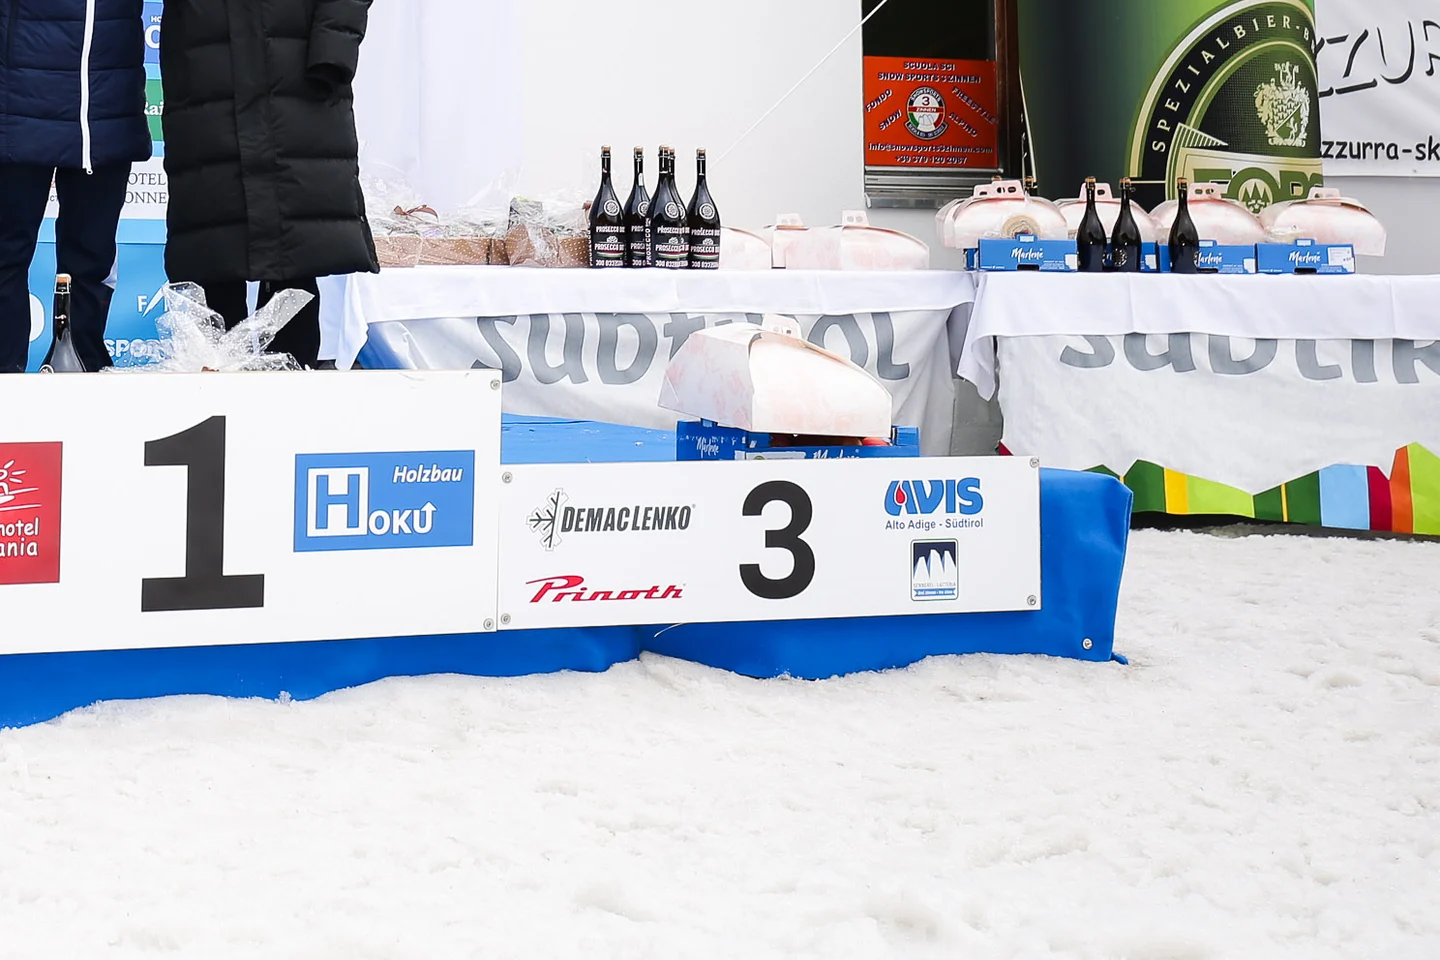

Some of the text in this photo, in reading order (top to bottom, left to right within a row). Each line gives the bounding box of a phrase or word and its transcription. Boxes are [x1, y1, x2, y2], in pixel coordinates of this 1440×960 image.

[904, 62, 956, 71] SCUOLA SCI
[878, 72, 904, 81] SNOW
[905, 73, 940, 82] SPORTS
[948, 75, 981, 84] ZINNEN
[866, 88, 893, 112] FONDO
[921, 96, 930, 106] 3
[951, 87, 996, 125] FREESTYLE
[879, 109, 902, 131] SNOW
[948, 112, 978, 138] ALPINO
[127, 172, 166, 186] OTEL
[1011, 247, 1044, 260] Marlene
[1288, 251, 1321, 266] Marlene
[392, 463, 463, 485] Holzbau
[883, 477, 984, 518] AVIS
[141, 415, 265, 613] 1
[885, 517, 984, 532] Alto Adige Südtirol
[739, 480, 816, 600] 3
[525, 574, 684, 603] Prinoth
